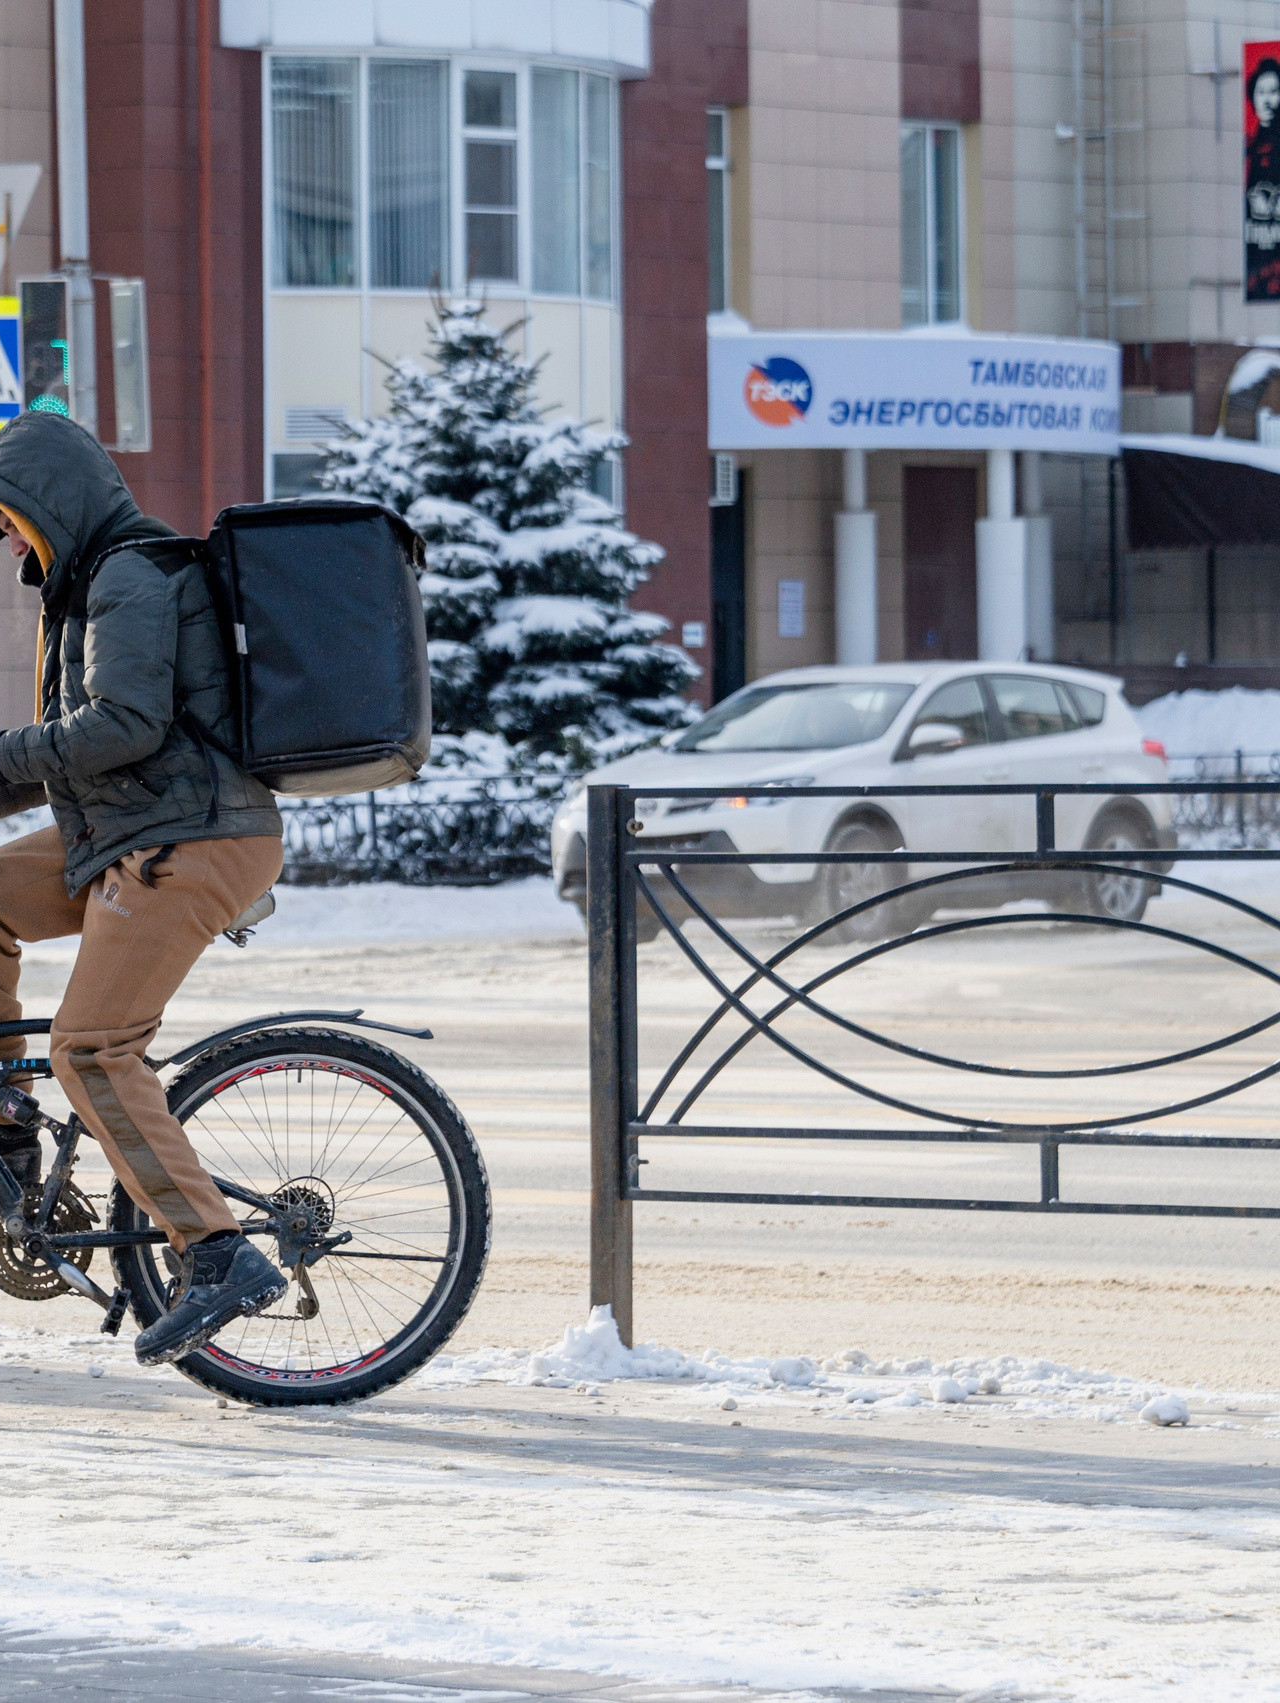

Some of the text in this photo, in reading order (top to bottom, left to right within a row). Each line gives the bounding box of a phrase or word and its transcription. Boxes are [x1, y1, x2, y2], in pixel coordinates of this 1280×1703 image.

[970, 360, 1107, 392] ТАМБОВСКАЯ
[828, 399, 1081, 431] ЭНЕРГОСБЫТОВАЯ
[12, 1058, 37, 1069] FUN
[261, 1060, 346, 1073] VELO
